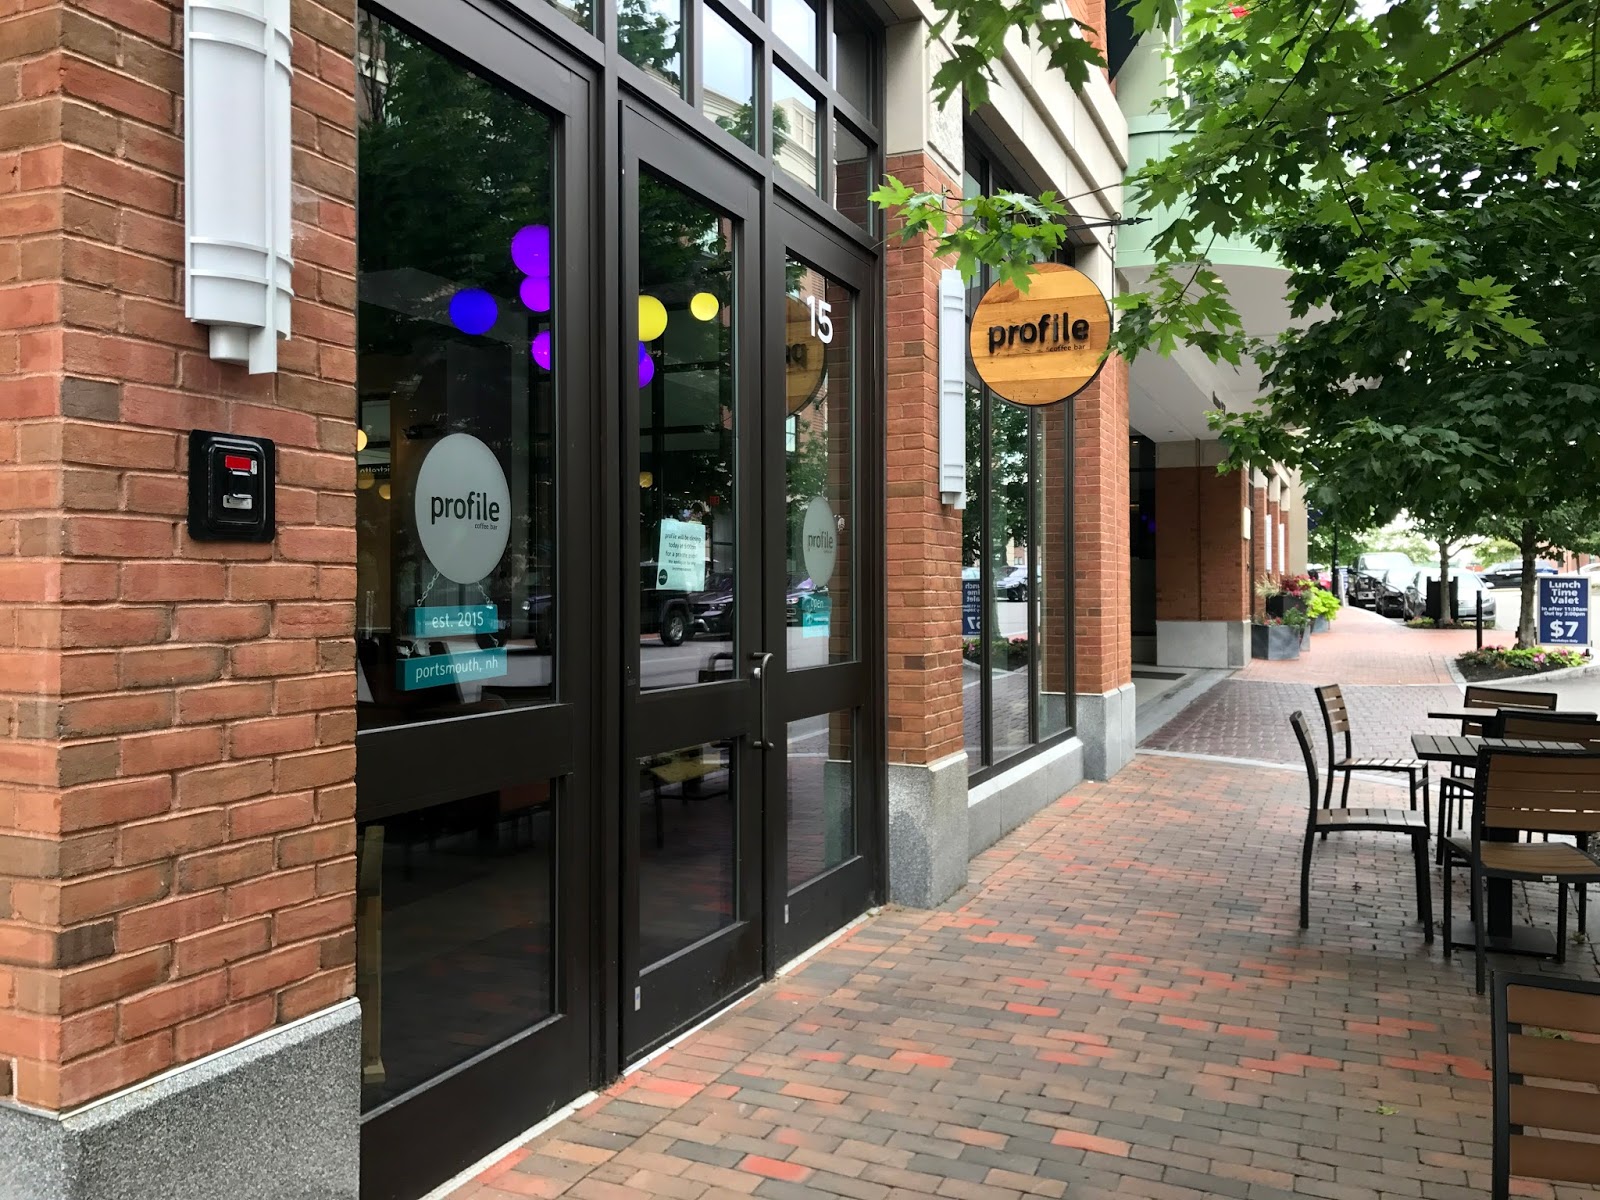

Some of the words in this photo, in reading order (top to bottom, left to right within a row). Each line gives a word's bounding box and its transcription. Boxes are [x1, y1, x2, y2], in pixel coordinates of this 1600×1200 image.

[807, 295, 834, 344] 15
[988, 312, 1090, 354] profile
[1074, 343, 1086, 351] bar
[431, 491, 500, 525] profile
[474, 522, 489, 530] coffee
[490, 523, 498, 531] bar
[808, 531, 834, 551] profile
[432, 613, 454, 628] est.
[457, 611, 484, 627] 2015
[1550, 619, 1578, 638] $7
[415, 657, 482, 683] portsmouth,
[485, 655, 498, 669] nh
